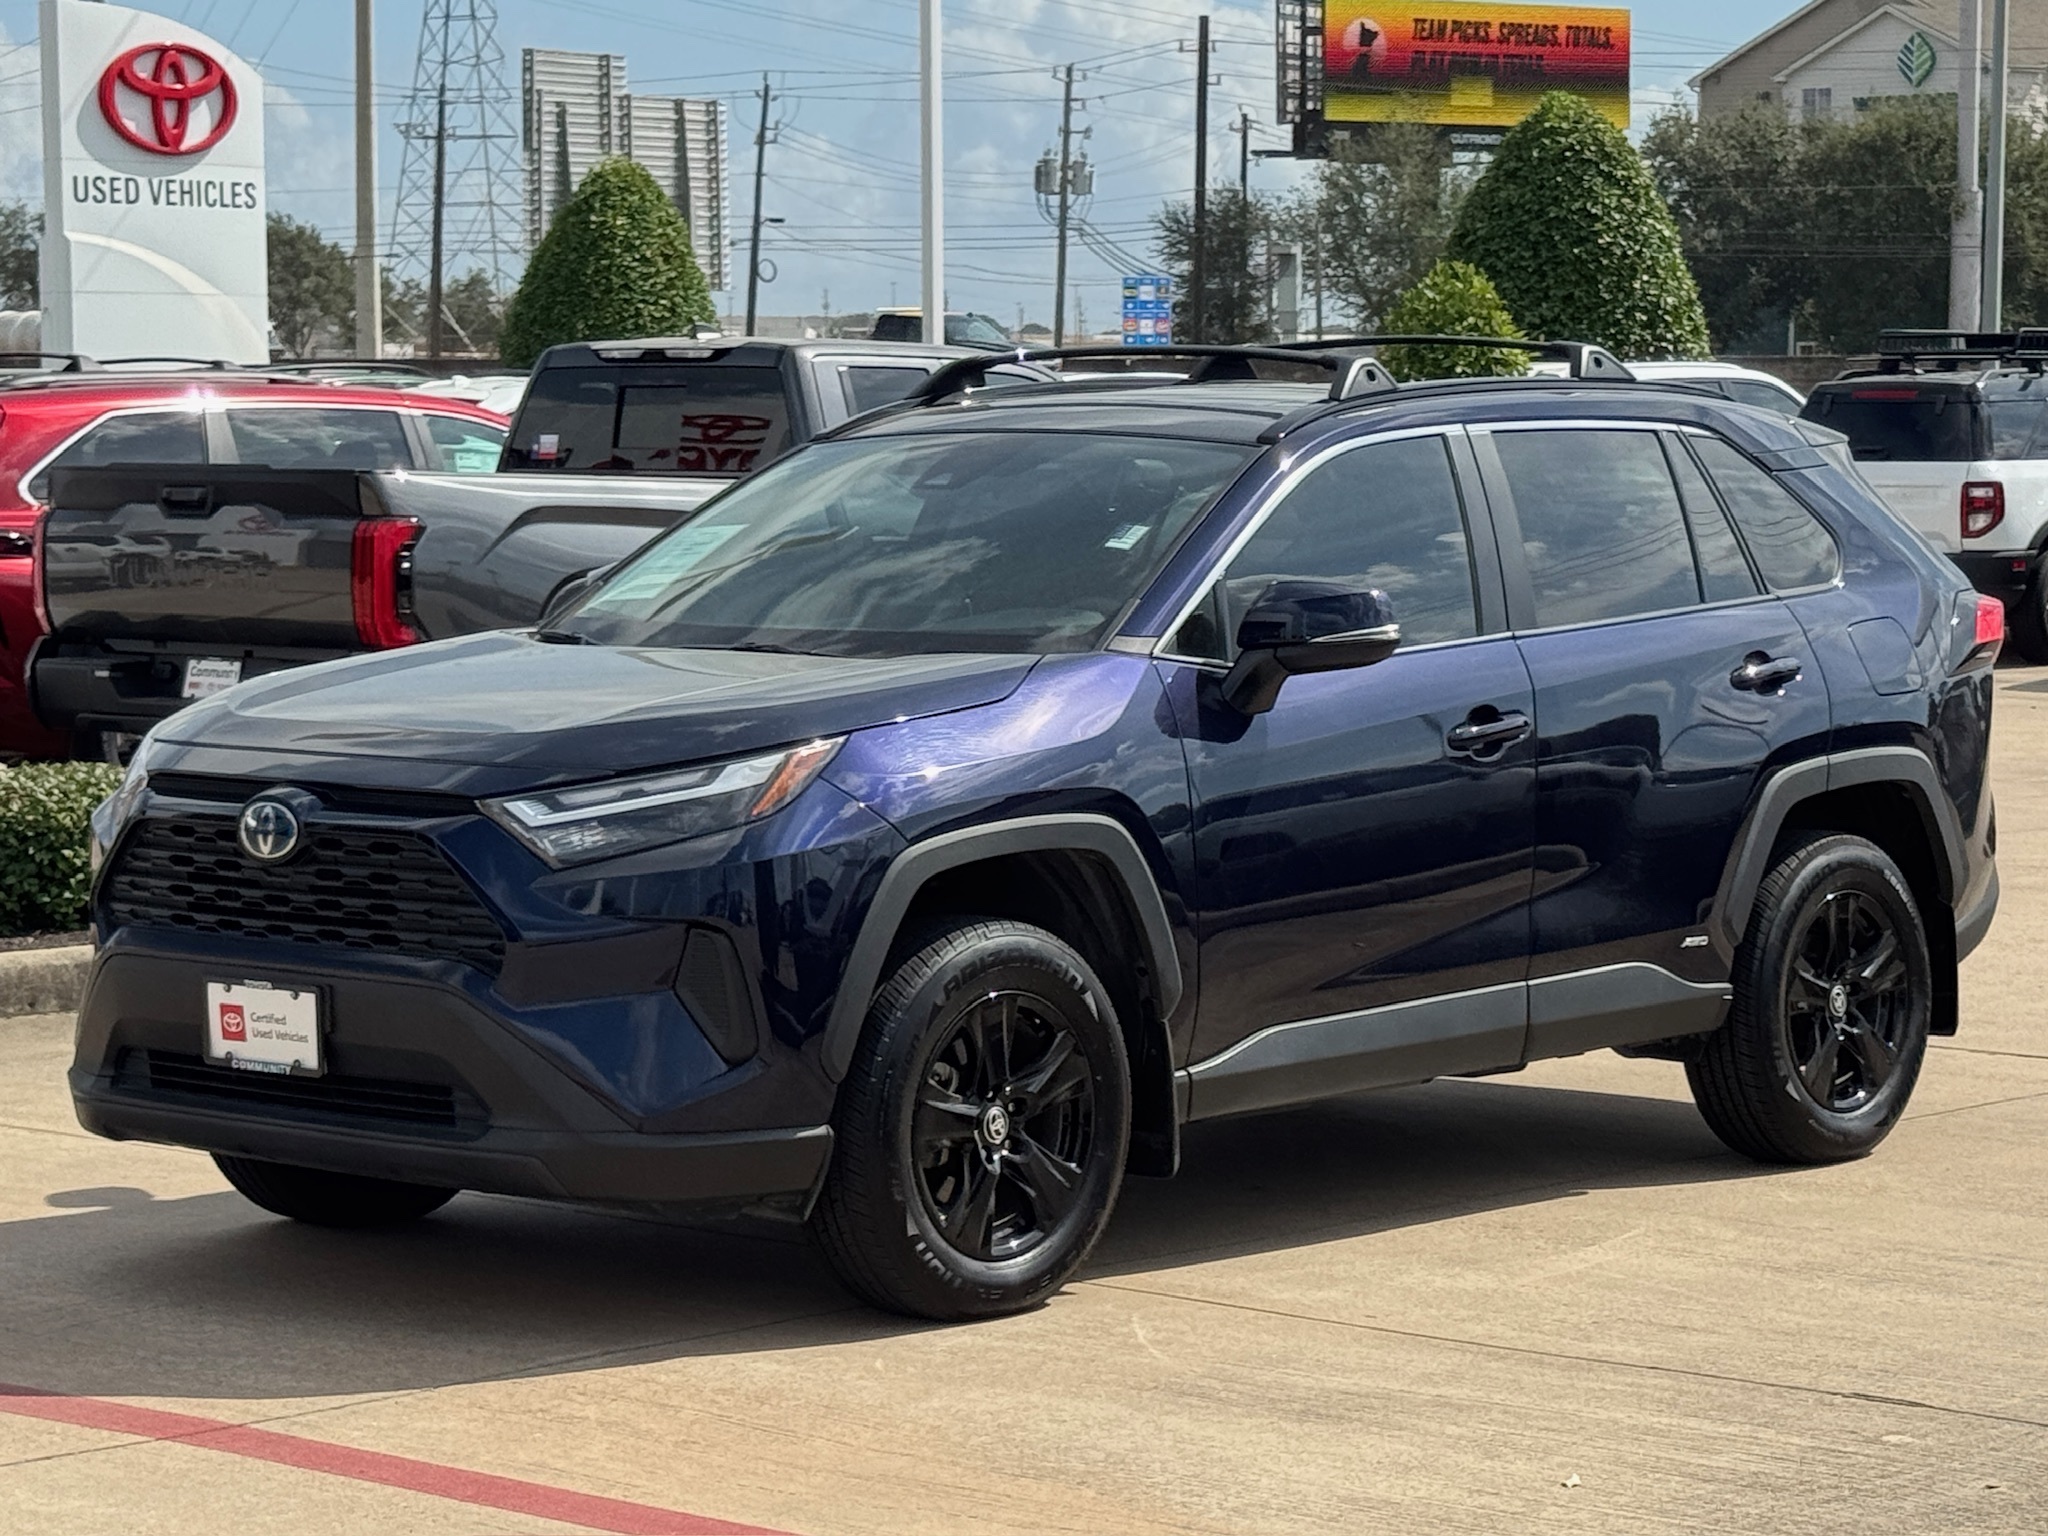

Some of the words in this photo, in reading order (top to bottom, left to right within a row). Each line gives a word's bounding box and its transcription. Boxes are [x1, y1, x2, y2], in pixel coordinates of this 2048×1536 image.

[1412, 17, 1448, 41] TEAM
[73, 175, 140, 205] USED
[148, 178, 257, 210] VEHICLES
[250, 1011, 287, 1025] Certified
[252, 1028, 273, 1040] Used
[275, 1031, 309, 1043] Vehicles
[231, 1058, 292, 1075] COMMUNITY
